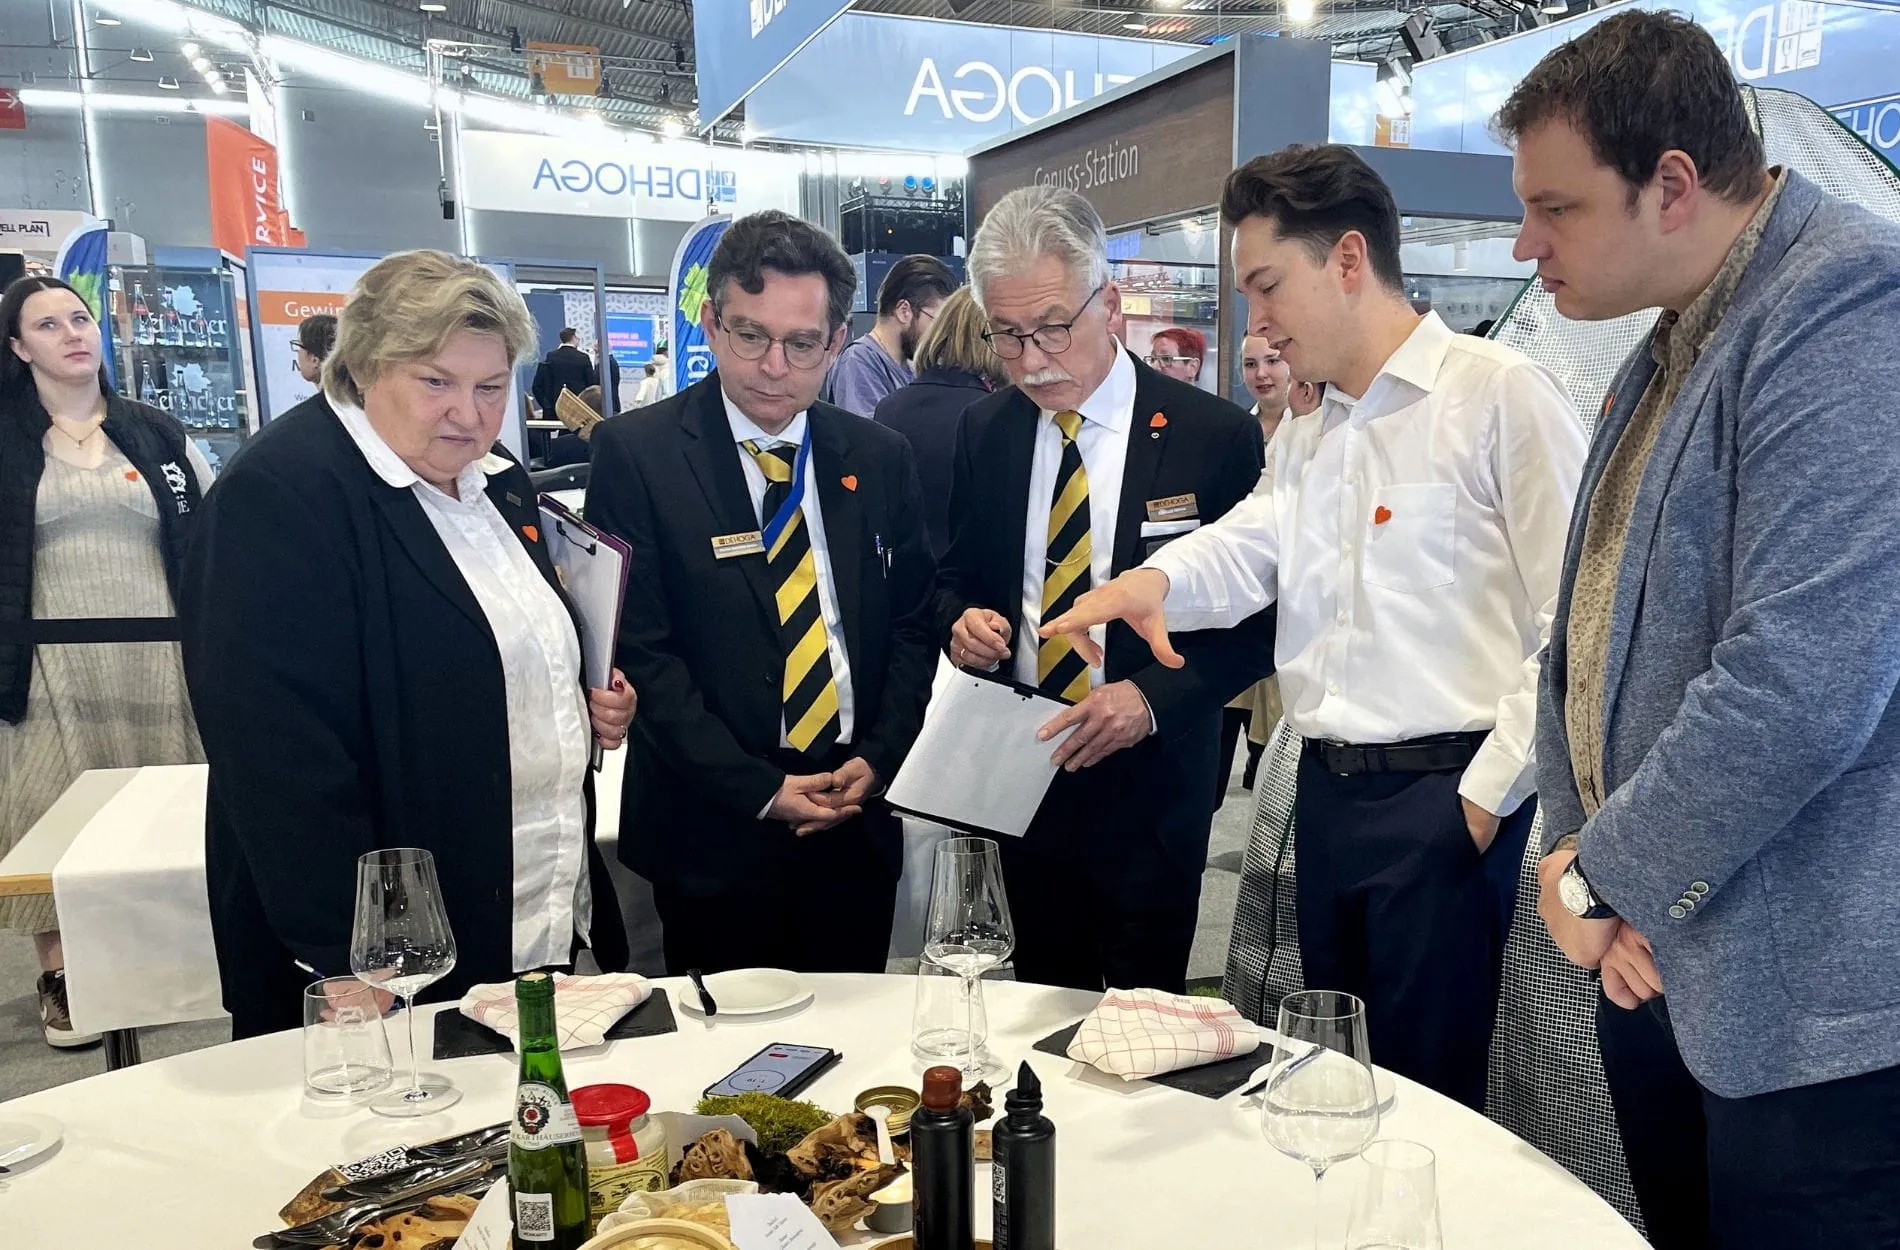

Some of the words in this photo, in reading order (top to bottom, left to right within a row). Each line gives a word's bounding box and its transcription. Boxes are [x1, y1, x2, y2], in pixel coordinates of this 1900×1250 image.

[252, 156, 273, 246] RVICE
[18, 223, 44, 234] PLAN
[725, 534, 756, 545] DEHOGA
